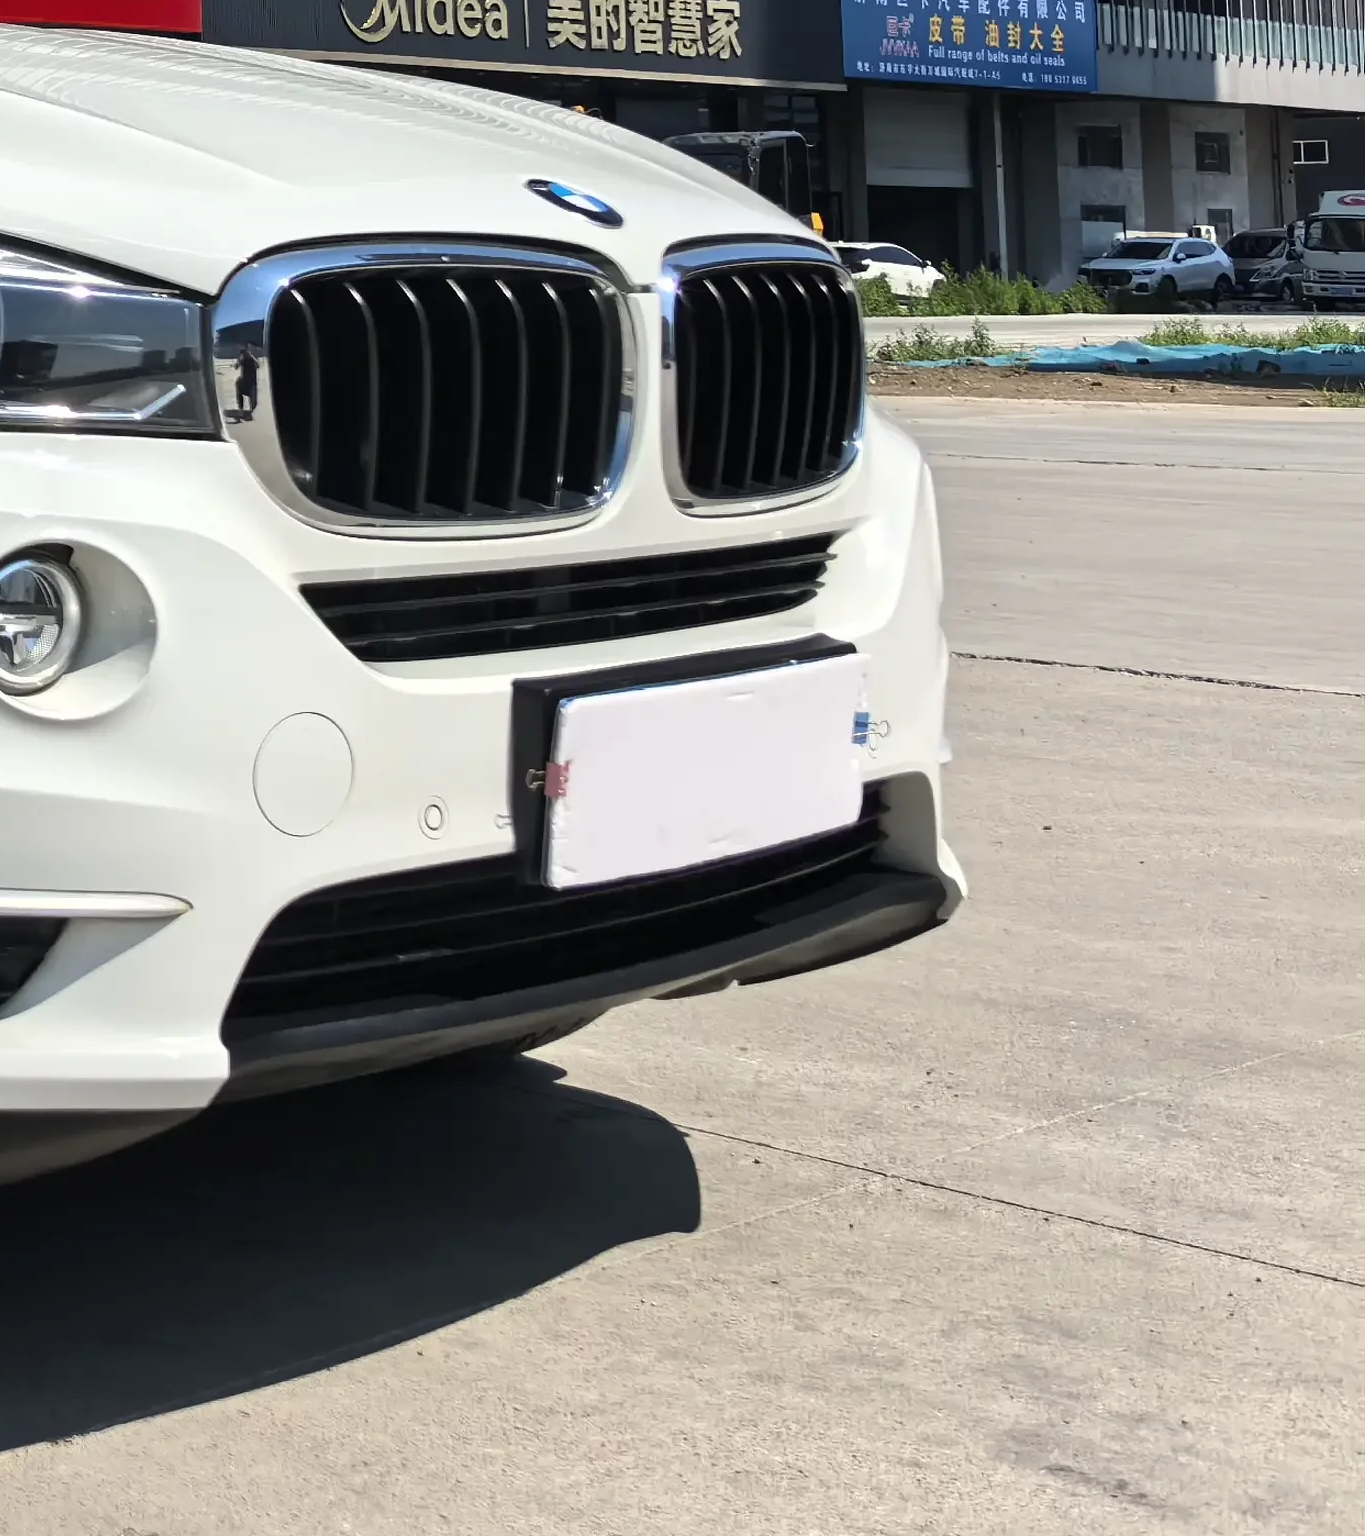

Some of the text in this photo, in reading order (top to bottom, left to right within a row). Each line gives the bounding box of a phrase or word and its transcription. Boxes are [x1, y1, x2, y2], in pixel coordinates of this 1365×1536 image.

[928, 14, 1065, 52] 皮带 油封大全
[928, 45, 945, 58] Full
[948, 49, 973, 63] range
[975, 49, 985, 62] of
[987, 50, 1010, 63] belts
[1011, 52, 1028, 64] and
[1030, 53, 1041, 65] oil
[1044, 54, 1065, 67] seals
